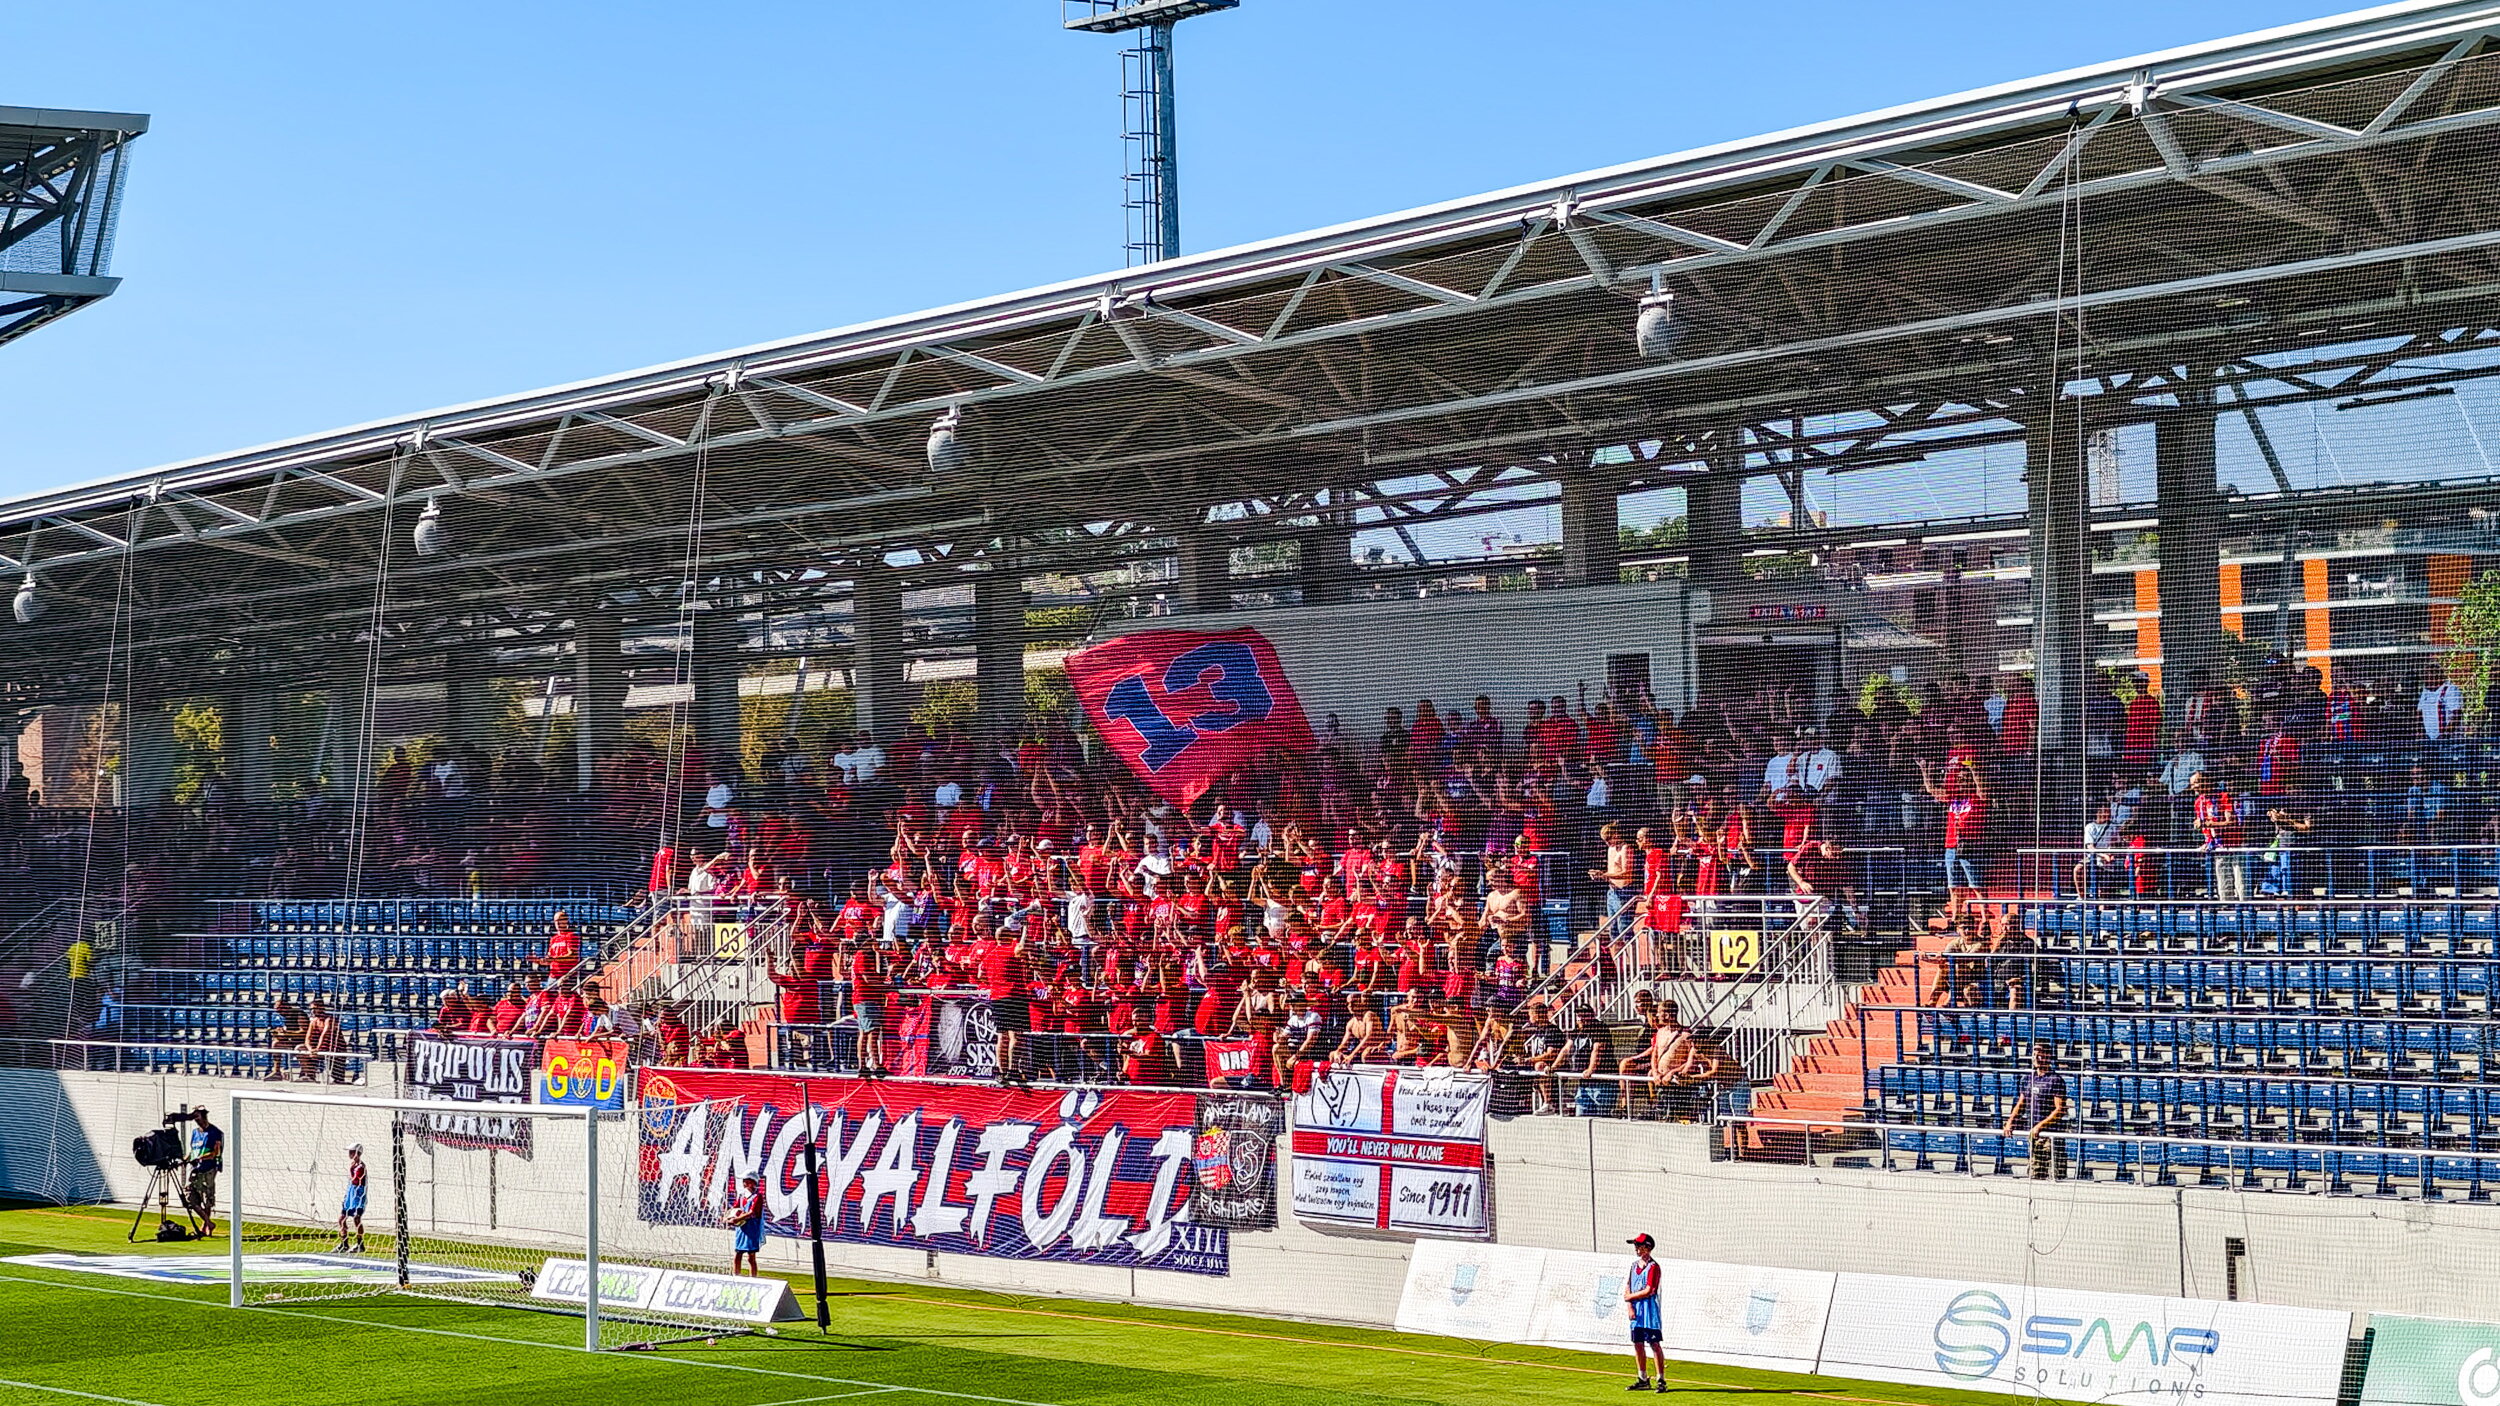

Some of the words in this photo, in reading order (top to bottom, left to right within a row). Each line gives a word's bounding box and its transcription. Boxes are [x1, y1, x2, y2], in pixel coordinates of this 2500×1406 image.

[1103, 641, 1275, 774] 13
[721, 927, 740, 953] C3
[1719, 935, 1750, 968] C2
[414, 1040, 525, 1093] TRIPOLIS
[546, 1049, 617, 1101] GÖD
[452, 1082, 478, 1099] XIII
[1203, 1100, 1272, 1125] ANGELLAND
[1327, 1137, 1359, 1154] YOU'LL
[1360, 1140, 1391, 1157] NEVER
[1391, 1142, 1416, 1159] WALK
[1416, 1145, 1446, 1161] ALONE
[1200, 1193, 1266, 1219] FIGHTERS
[1399, 1185, 1426, 1204] Since
[1428, 1181, 1473, 1218] 1911
[1173, 1225, 1222, 1254] XIII
[2021, 1315, 2220, 1366] SMP
[2014, 1366, 2206, 1398] SOLUTIONS
